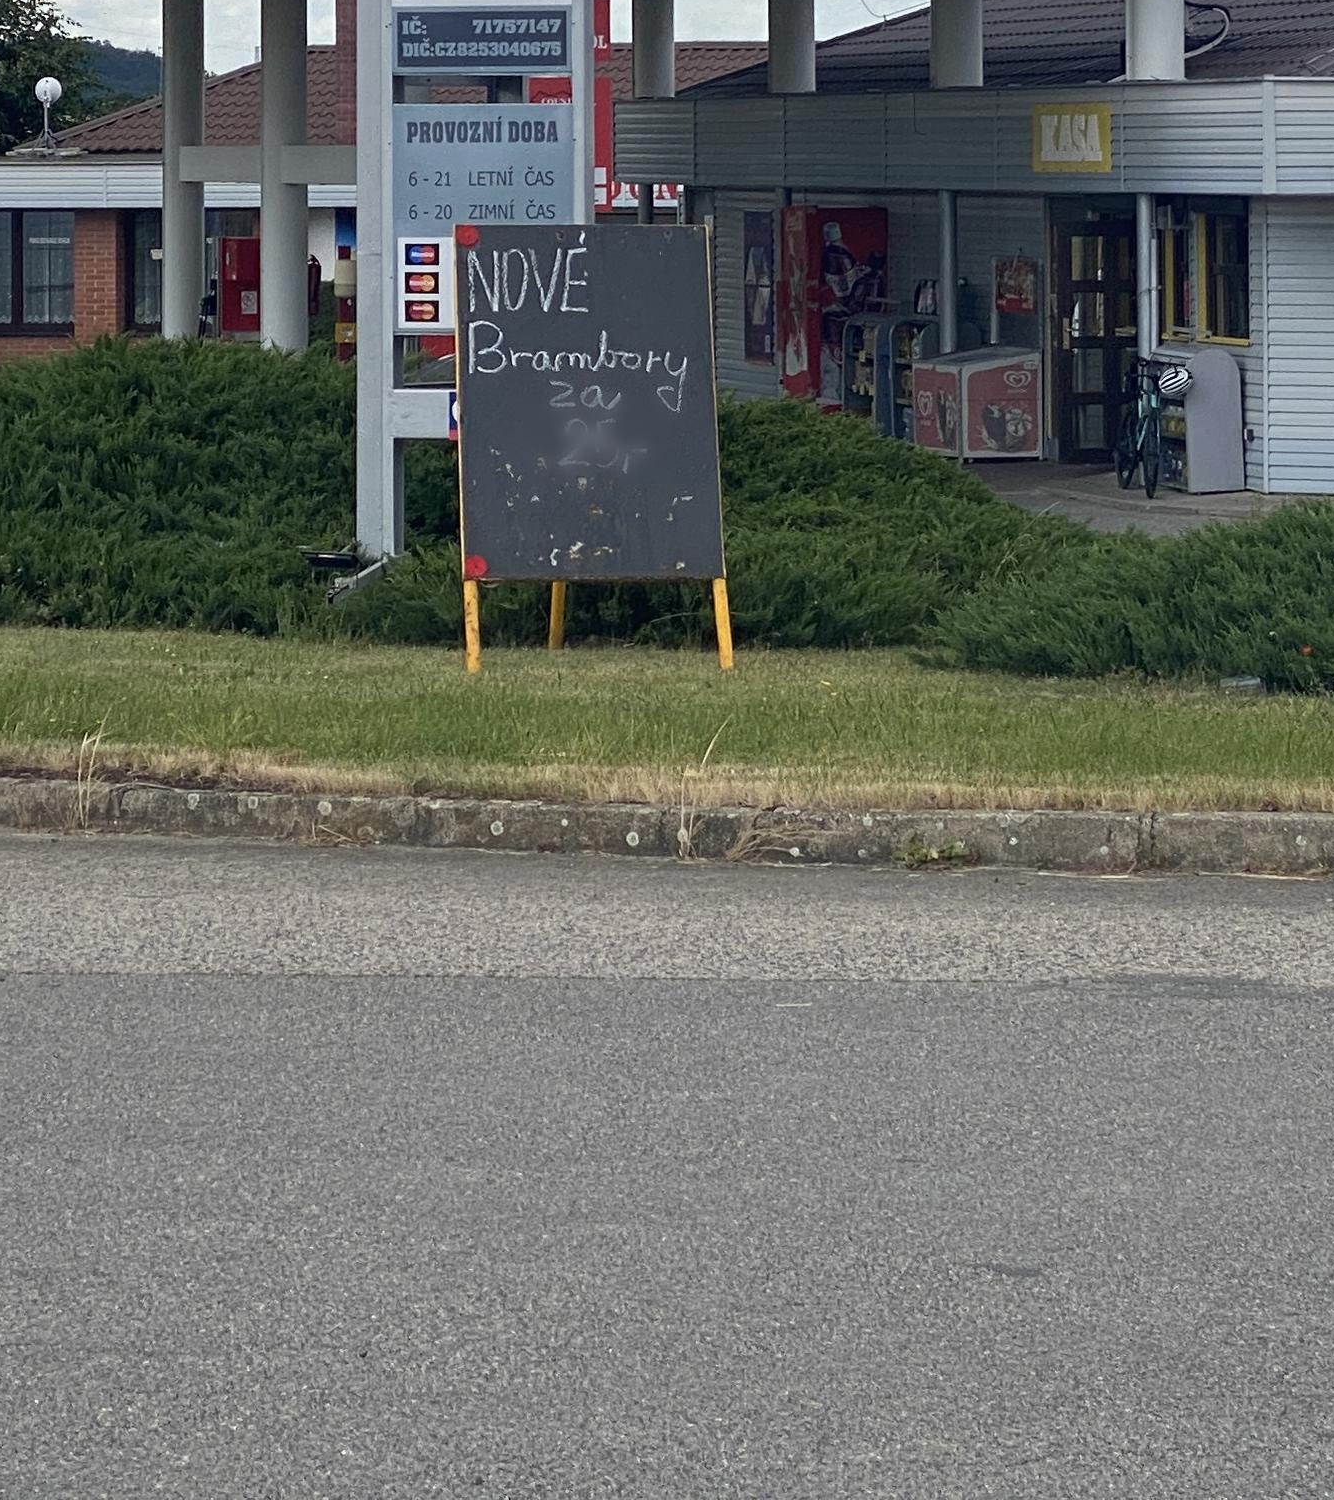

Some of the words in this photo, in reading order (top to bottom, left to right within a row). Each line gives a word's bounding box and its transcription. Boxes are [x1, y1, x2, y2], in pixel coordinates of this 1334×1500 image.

[472, 19, 561, 35] 71757147
[406, 116, 502, 143] PROVOZNÍ
[508, 121, 559, 143] DOBA
[1040, 114, 1102, 162] KASA
[408, 171, 418, 187] 6
[434, 171, 452, 187] 21
[468, 166, 514, 187] LETNÍ
[524, 166, 555, 187] ČAS
[408, 204, 418, 220] 6
[434, 204, 453, 220] 20
[468, 199, 515, 220] ZIMNÍ
[525, 199, 556, 220] ČAS
[467, 230, 589, 313] NOVÉ
[468, 320, 688, 413] Brambory
